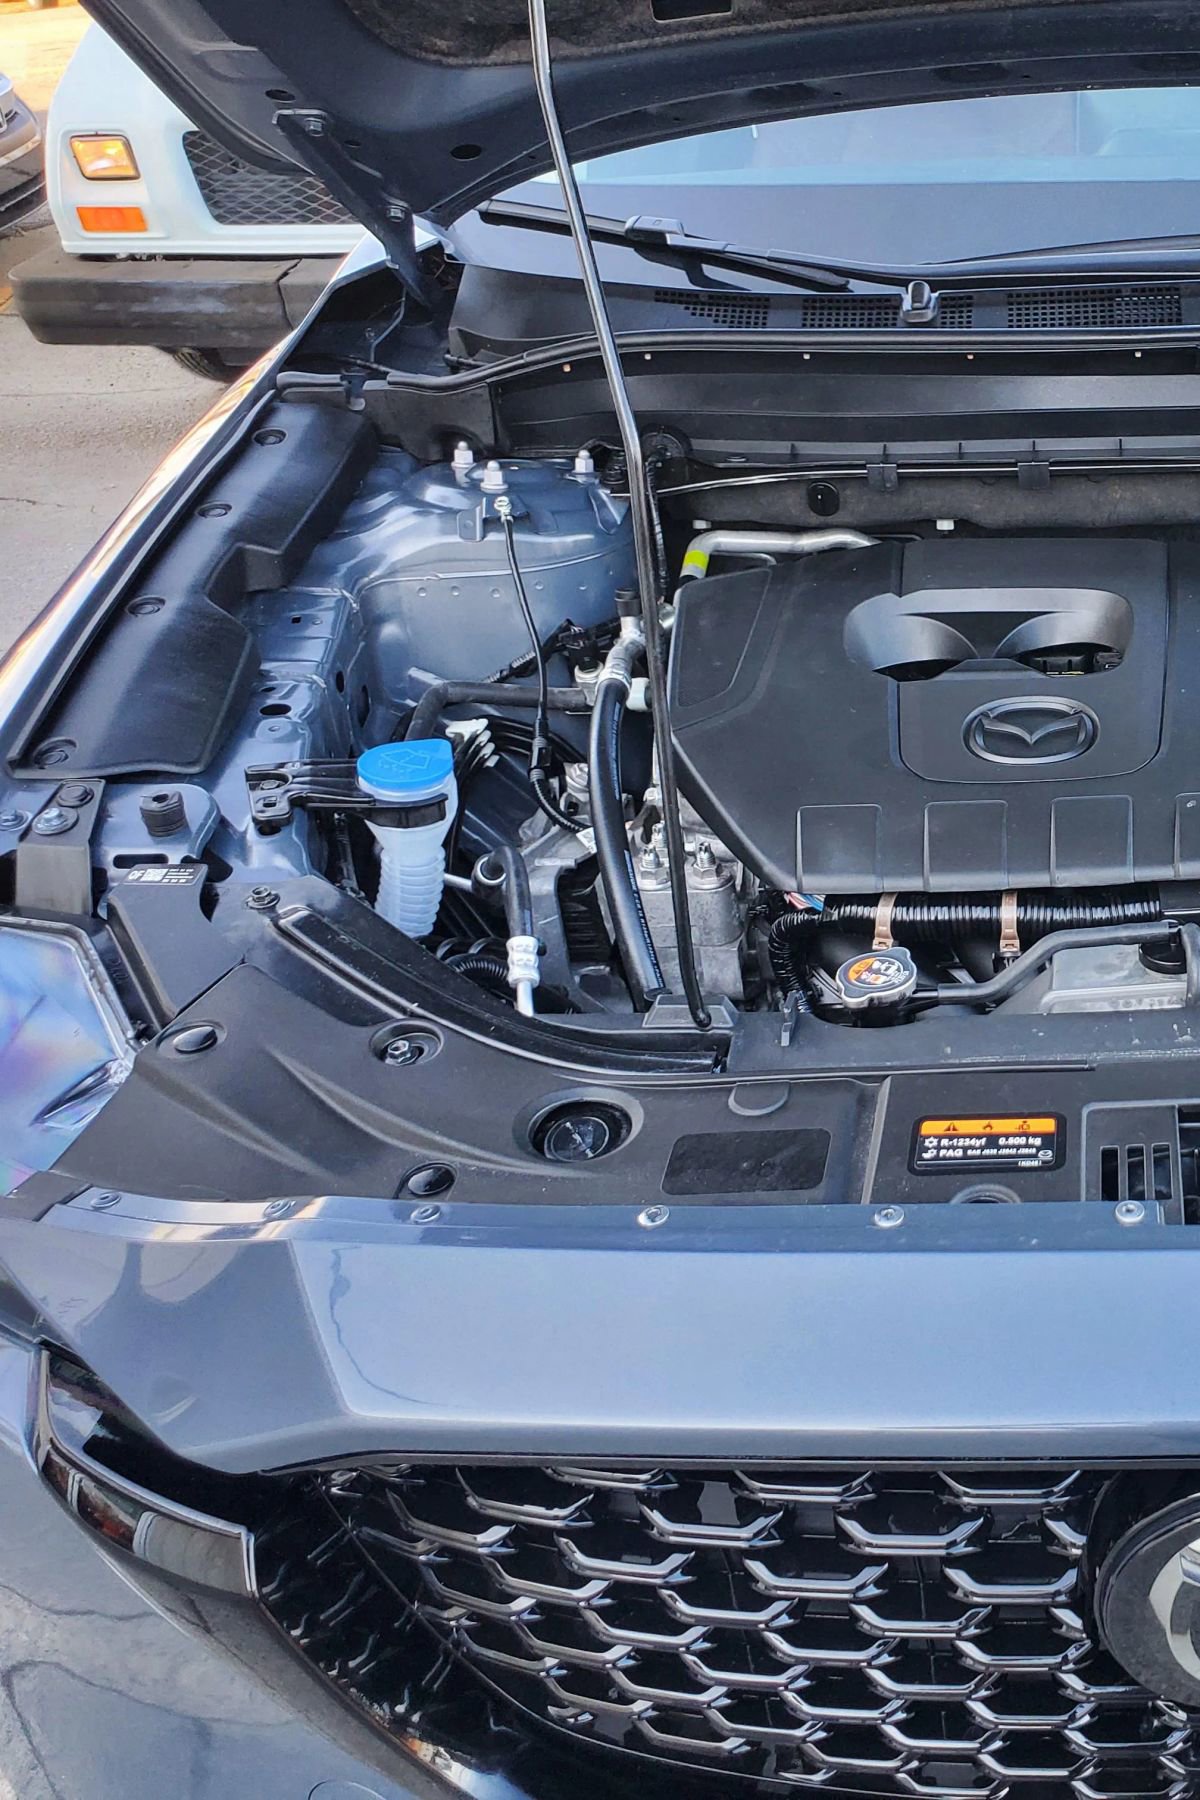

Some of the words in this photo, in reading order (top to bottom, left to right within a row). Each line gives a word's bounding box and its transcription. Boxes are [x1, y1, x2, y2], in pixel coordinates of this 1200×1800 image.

[940, 1137, 987, 1147] R-1234yf
[1028, 1136, 1042, 1147] kg
[939, 1148, 964, 1158] PAG
